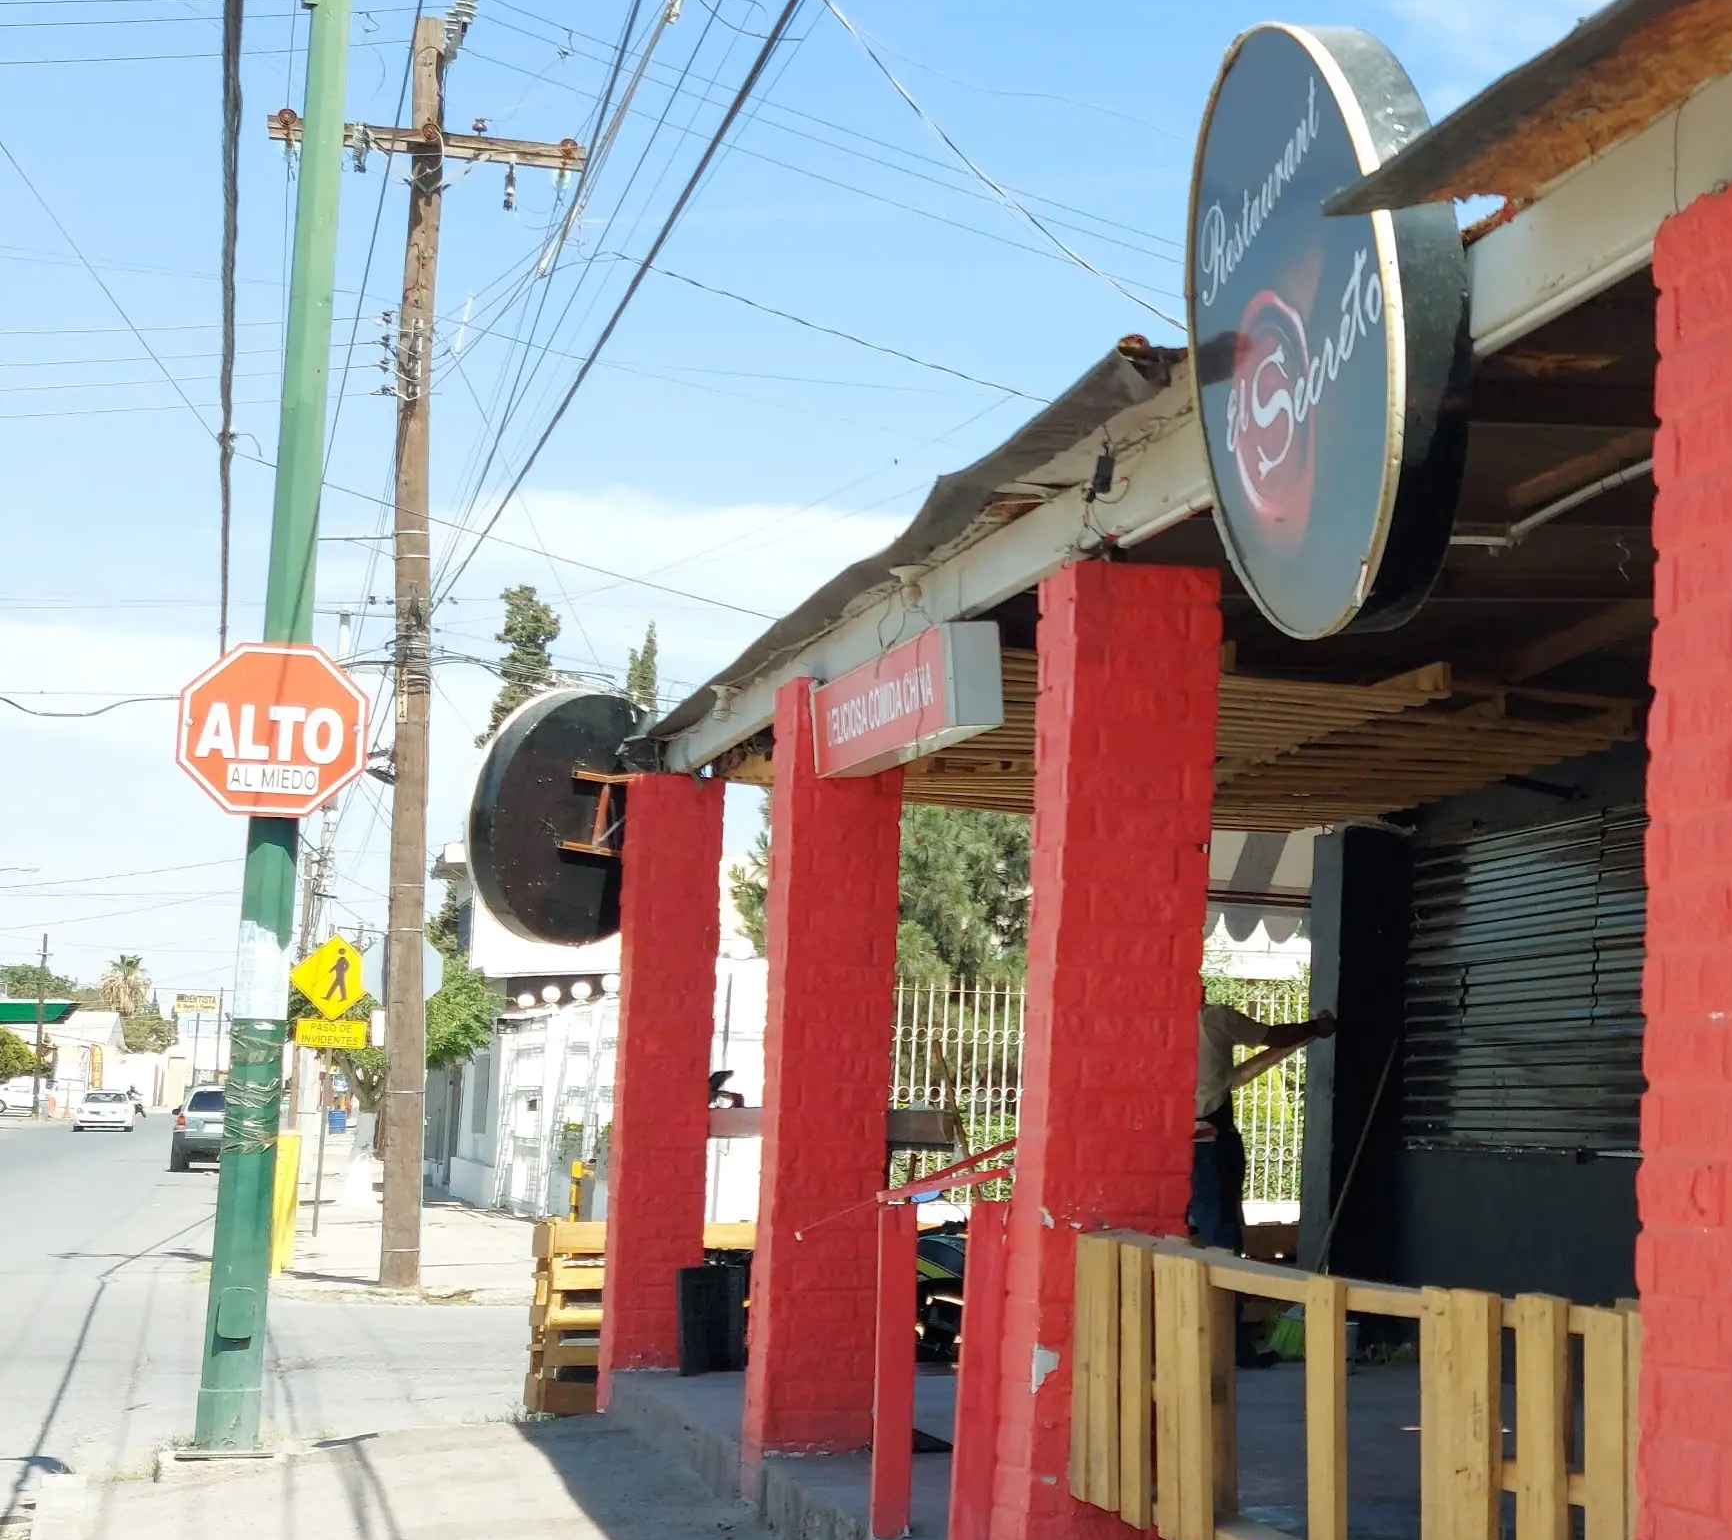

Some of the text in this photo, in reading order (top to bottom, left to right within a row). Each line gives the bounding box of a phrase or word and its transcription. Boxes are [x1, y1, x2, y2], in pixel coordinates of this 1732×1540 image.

[1202, 76, 1320, 306] Restaurant
[1251, 247, 1383, 480] Secreto
[868, 677, 904, 730] COMIDA
[902, 662, 934, 715] CHINA
[194, 702, 344, 764] ALTO
[230, 766, 317, 791] AL MIEDO
[185, 994, 217, 1004] DENTISTA
[301, 1034, 360, 1046] INVIDENTES
[311, 1022, 353, 1034] PASO DE
